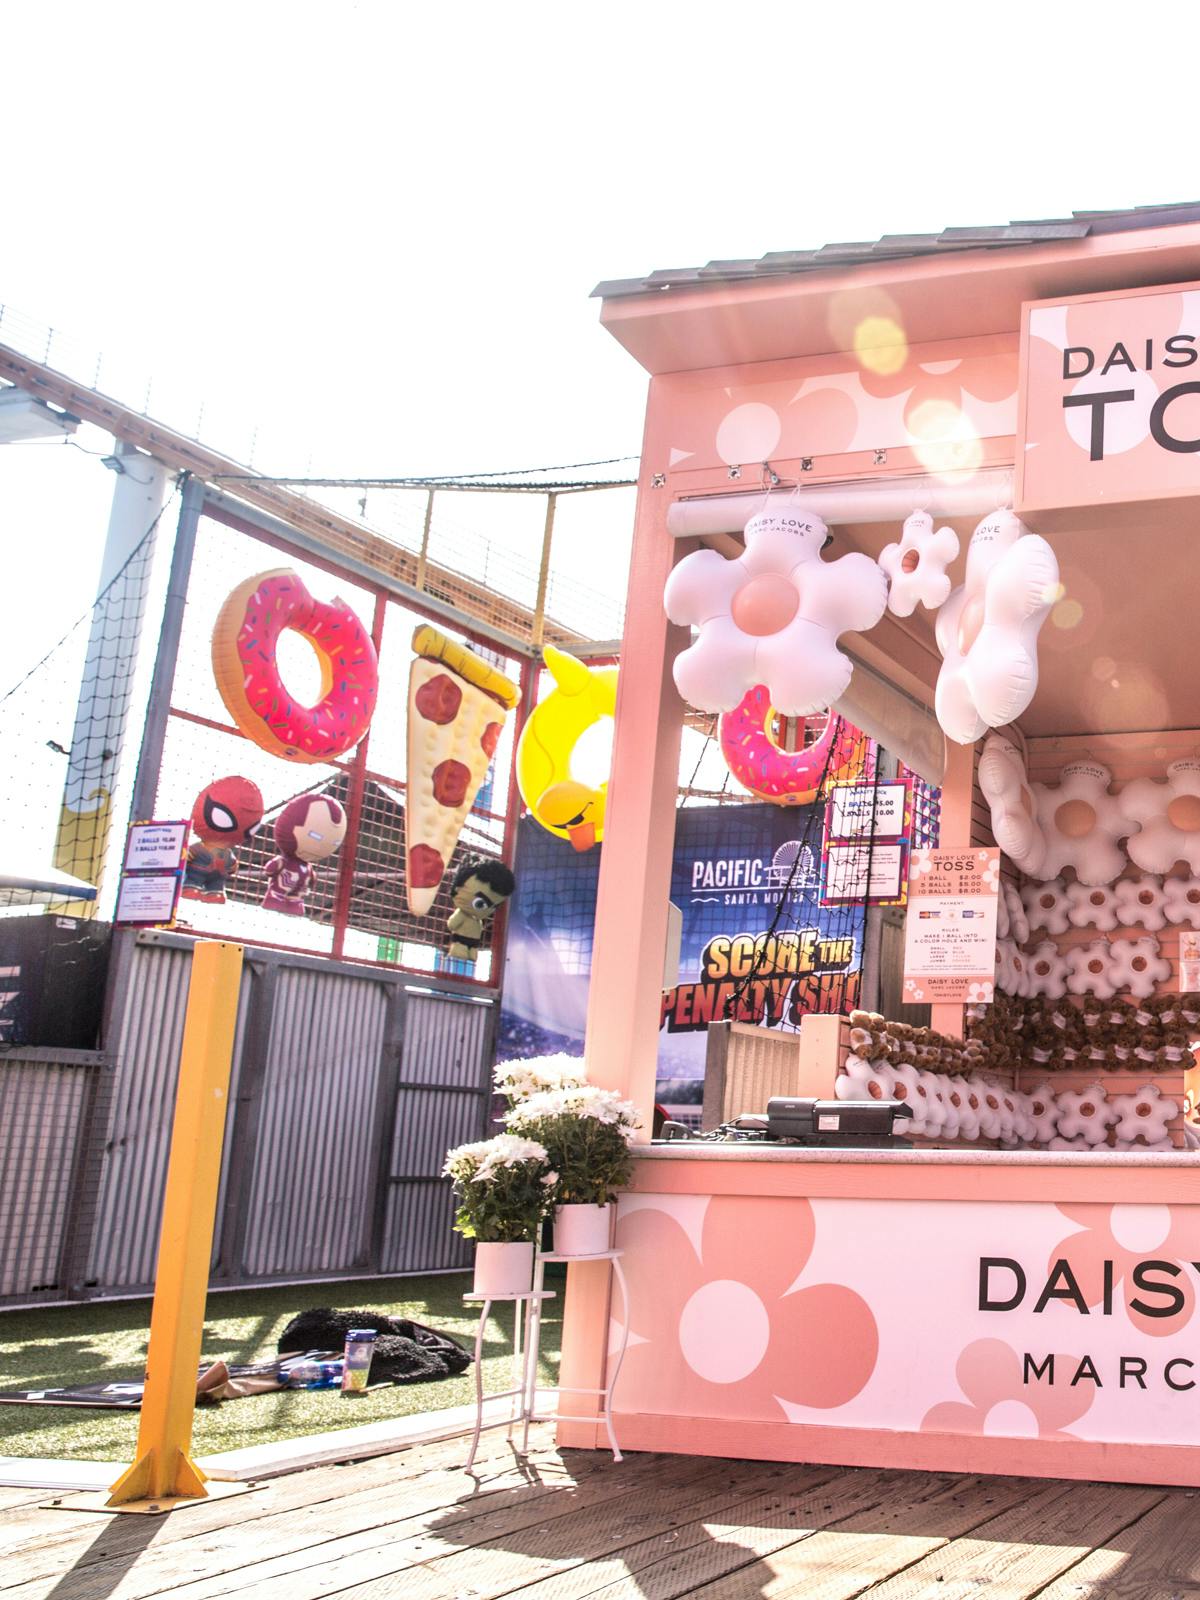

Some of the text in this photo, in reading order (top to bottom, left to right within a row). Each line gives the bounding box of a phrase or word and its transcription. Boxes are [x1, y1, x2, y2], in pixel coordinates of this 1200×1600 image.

[781, 519, 812, 532] LOVE
[692, 859, 762, 888] PACIFIC
[934, 861, 974, 871] TOSS
[724, 893, 758, 905] SANTA
[707, 930, 854, 978] SCORE THE
[660, 977, 792, 1025] PENALTY
[1023, 1353, 1197, 1391] MARC
